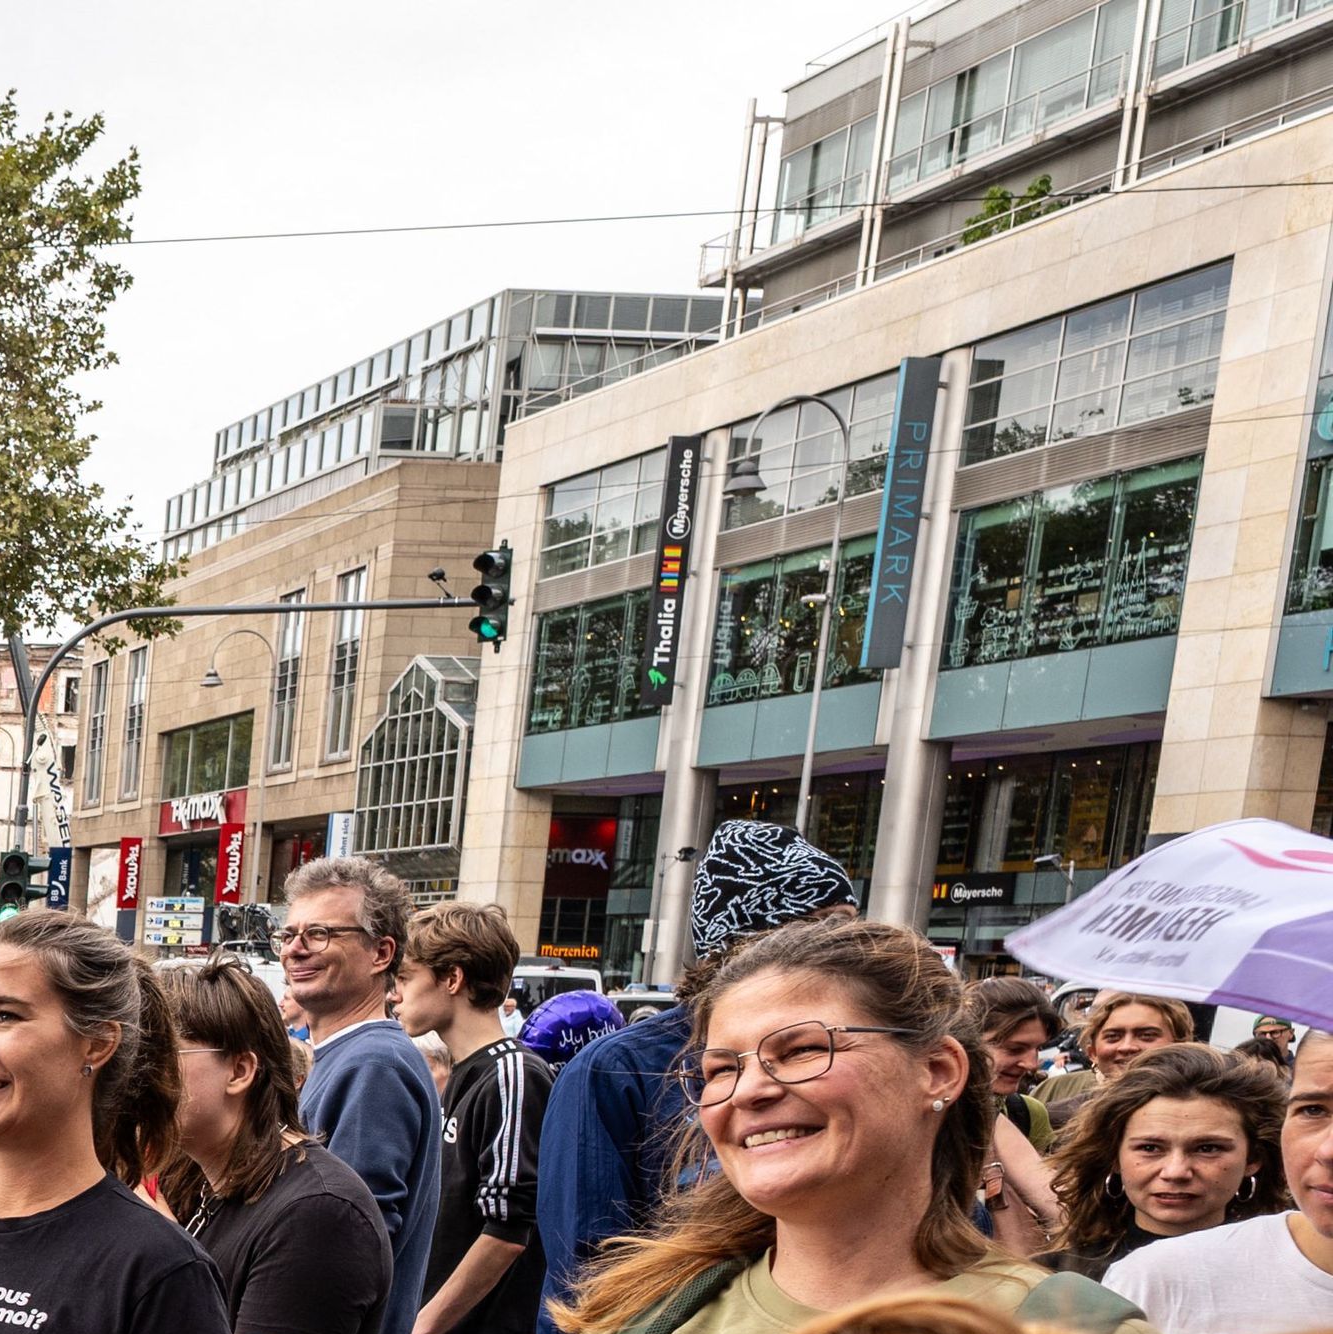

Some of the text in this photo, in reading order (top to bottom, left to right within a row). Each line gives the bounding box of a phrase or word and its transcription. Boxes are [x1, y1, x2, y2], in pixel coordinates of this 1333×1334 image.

[671, 448, 693, 535] Mayersche
[880, 421, 928, 604] PRIMARK
[652, 599, 676, 667] Thalia
[48, 859, 69, 883] Bank
[50, 888, 60, 902] BB
[953, 885, 1004, 900] Mayersche
[540, 944, 599, 958] Merzenich
[559, 1021, 616, 1050] My body
